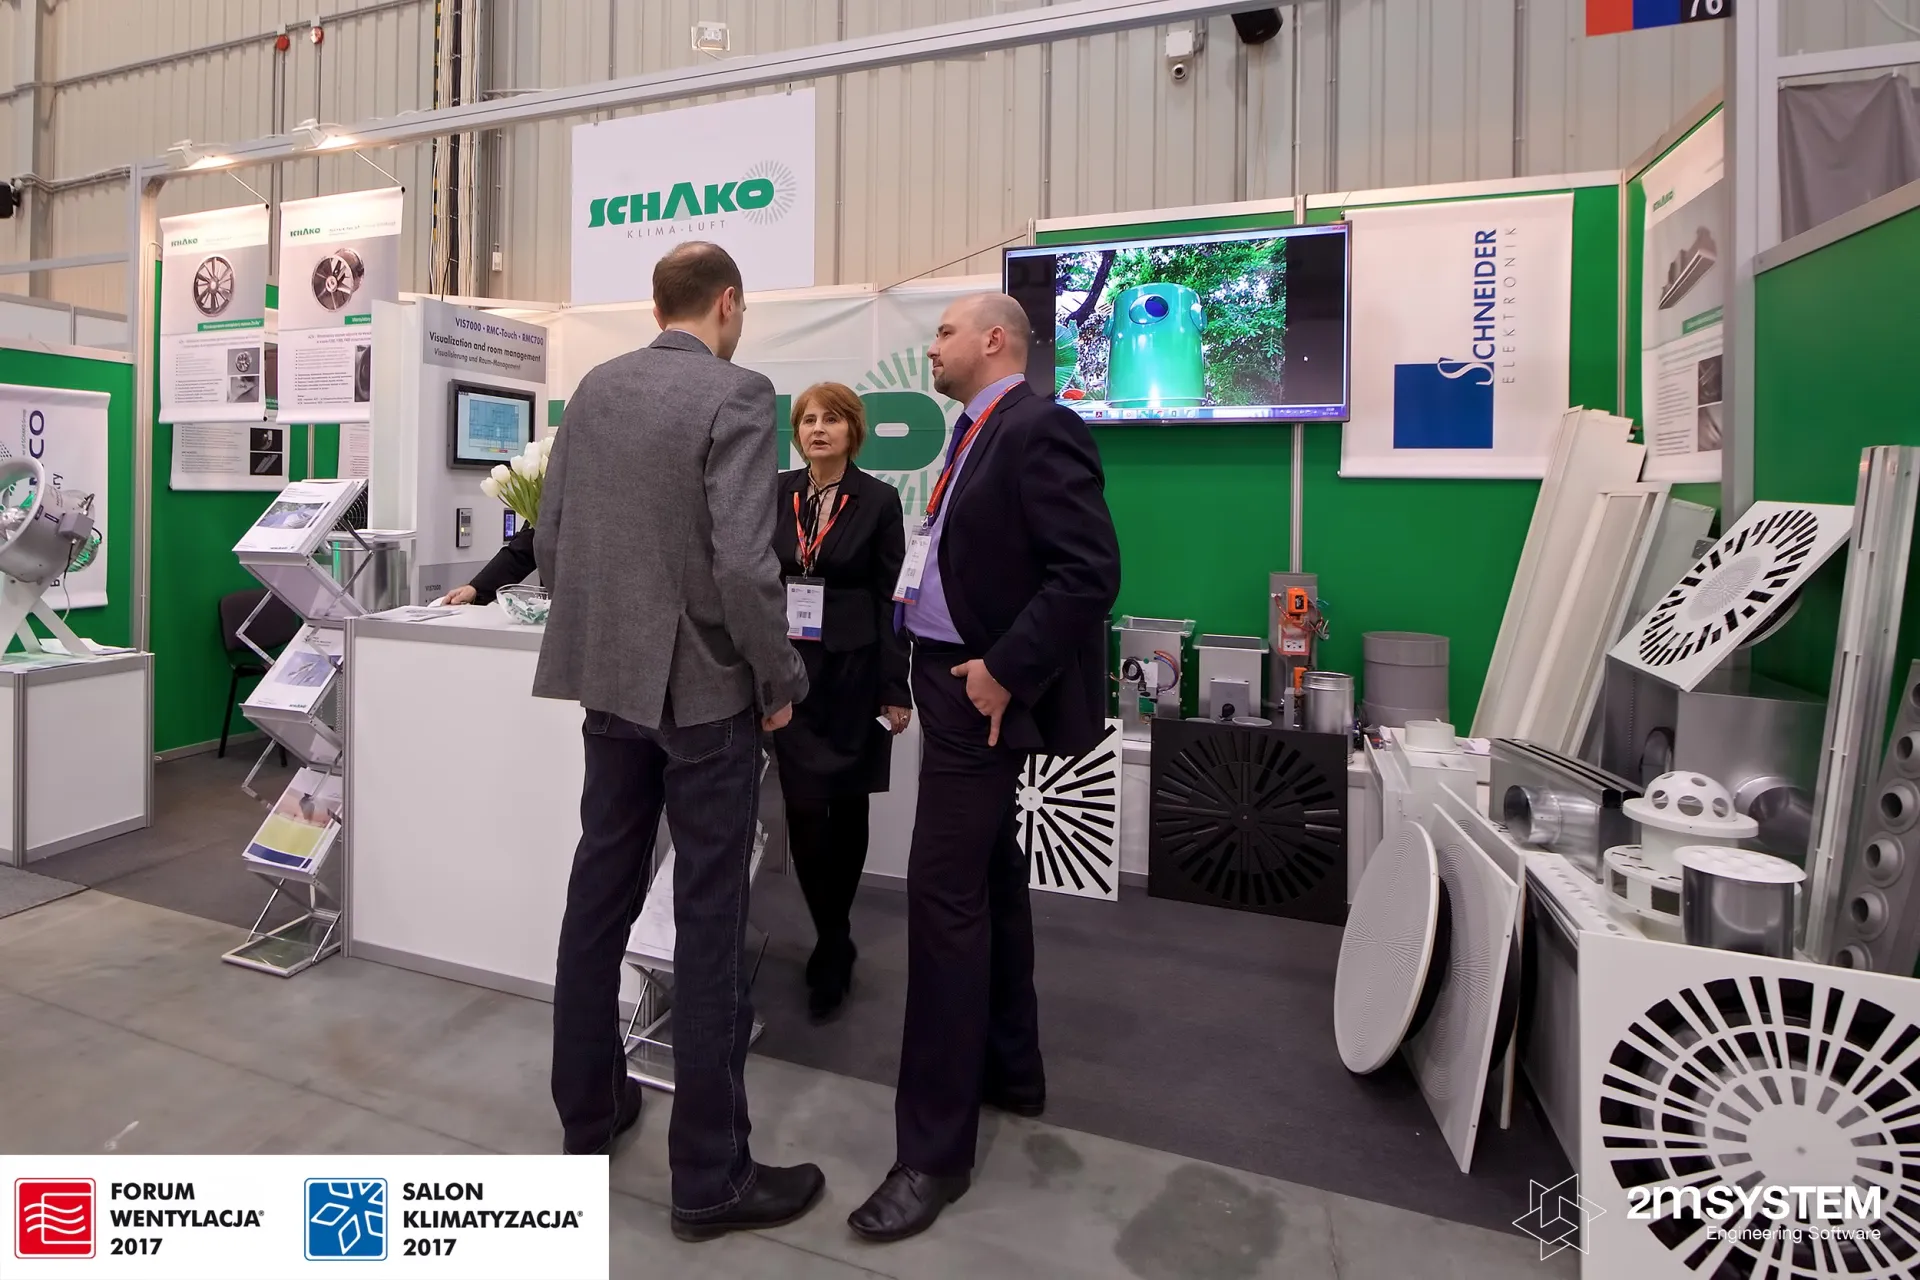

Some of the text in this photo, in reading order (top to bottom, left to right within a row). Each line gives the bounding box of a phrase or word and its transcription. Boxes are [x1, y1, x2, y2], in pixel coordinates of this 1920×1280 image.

[588, 178, 775, 228] SCHAKO
[627, 220, 727, 239] KLIMA-LUFT
[1437, 229, 1497, 386] SCHNEIDER
[1502, 227, 1517, 384] ELEKTRONIK
[429, 331, 541, 362] Visualization and room management
[455, 317, 544, 346] VIS7000 RMC-Touch RMC700
